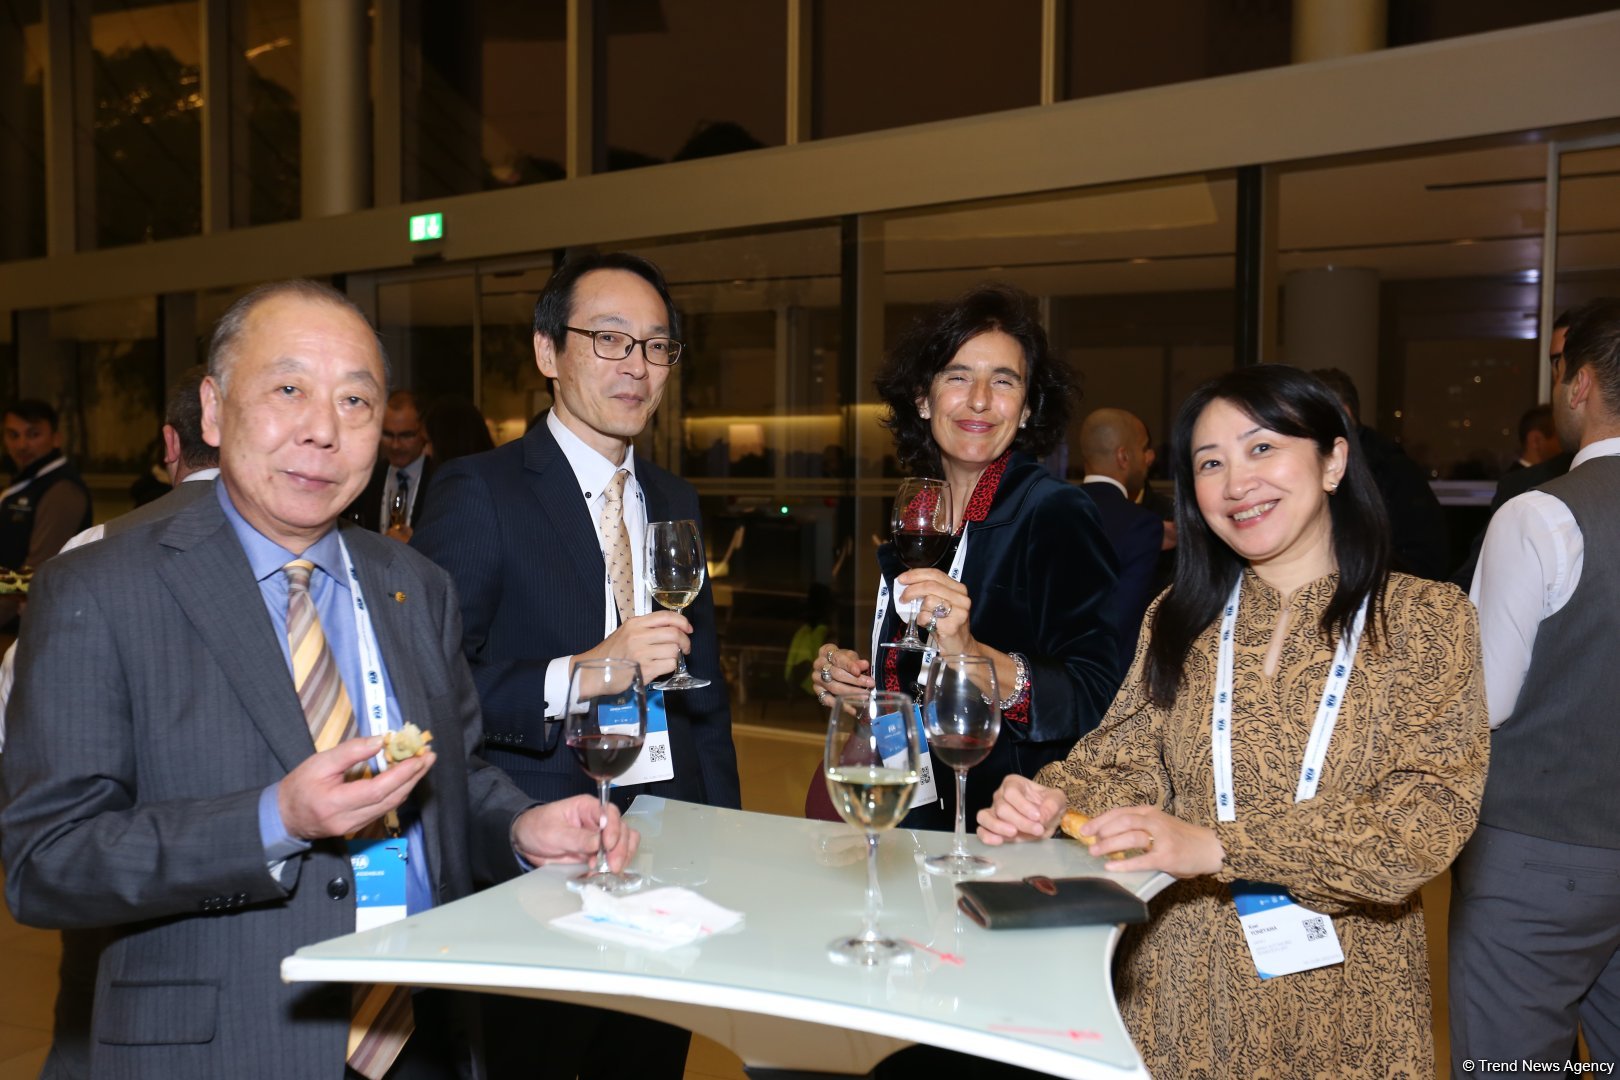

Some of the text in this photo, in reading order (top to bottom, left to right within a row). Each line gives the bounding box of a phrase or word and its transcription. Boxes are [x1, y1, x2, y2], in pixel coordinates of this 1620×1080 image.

[952, 568, 960, 579] FIA
[925, 652, 933, 663] FIA
[368, 671, 378, 685] FIA
[1334, 664, 1345, 678] FIA
[1219, 691, 1227, 703] FIA
[1326, 694, 1337, 708] FIA
[373, 705, 382, 719] FIA
[1217, 718, 1226, 731] FIA
[1305, 767, 1315, 782] FIA
[1220, 792, 1228, 806] FIA
